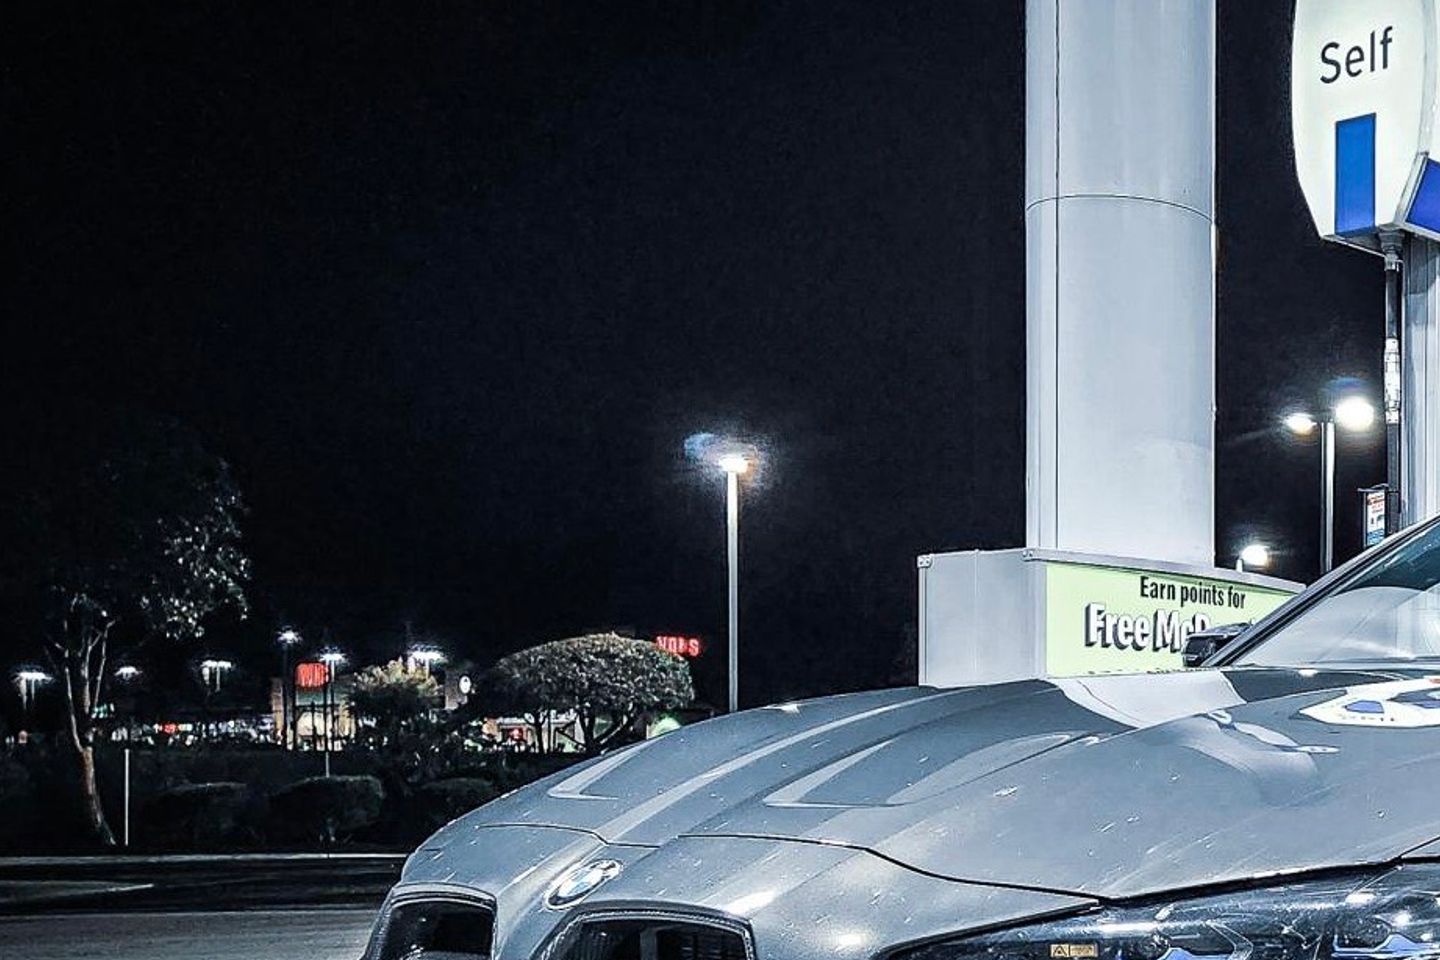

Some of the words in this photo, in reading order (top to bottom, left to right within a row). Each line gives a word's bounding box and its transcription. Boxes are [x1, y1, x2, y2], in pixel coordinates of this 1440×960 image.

[1320, 25, 1394, 85] Self
[1140, 575, 1176, 601] Earn
[1180, 582, 1225, 608] points
[1228, 586, 1247, 610] for
[1084, 602, 1150, 650] Free
